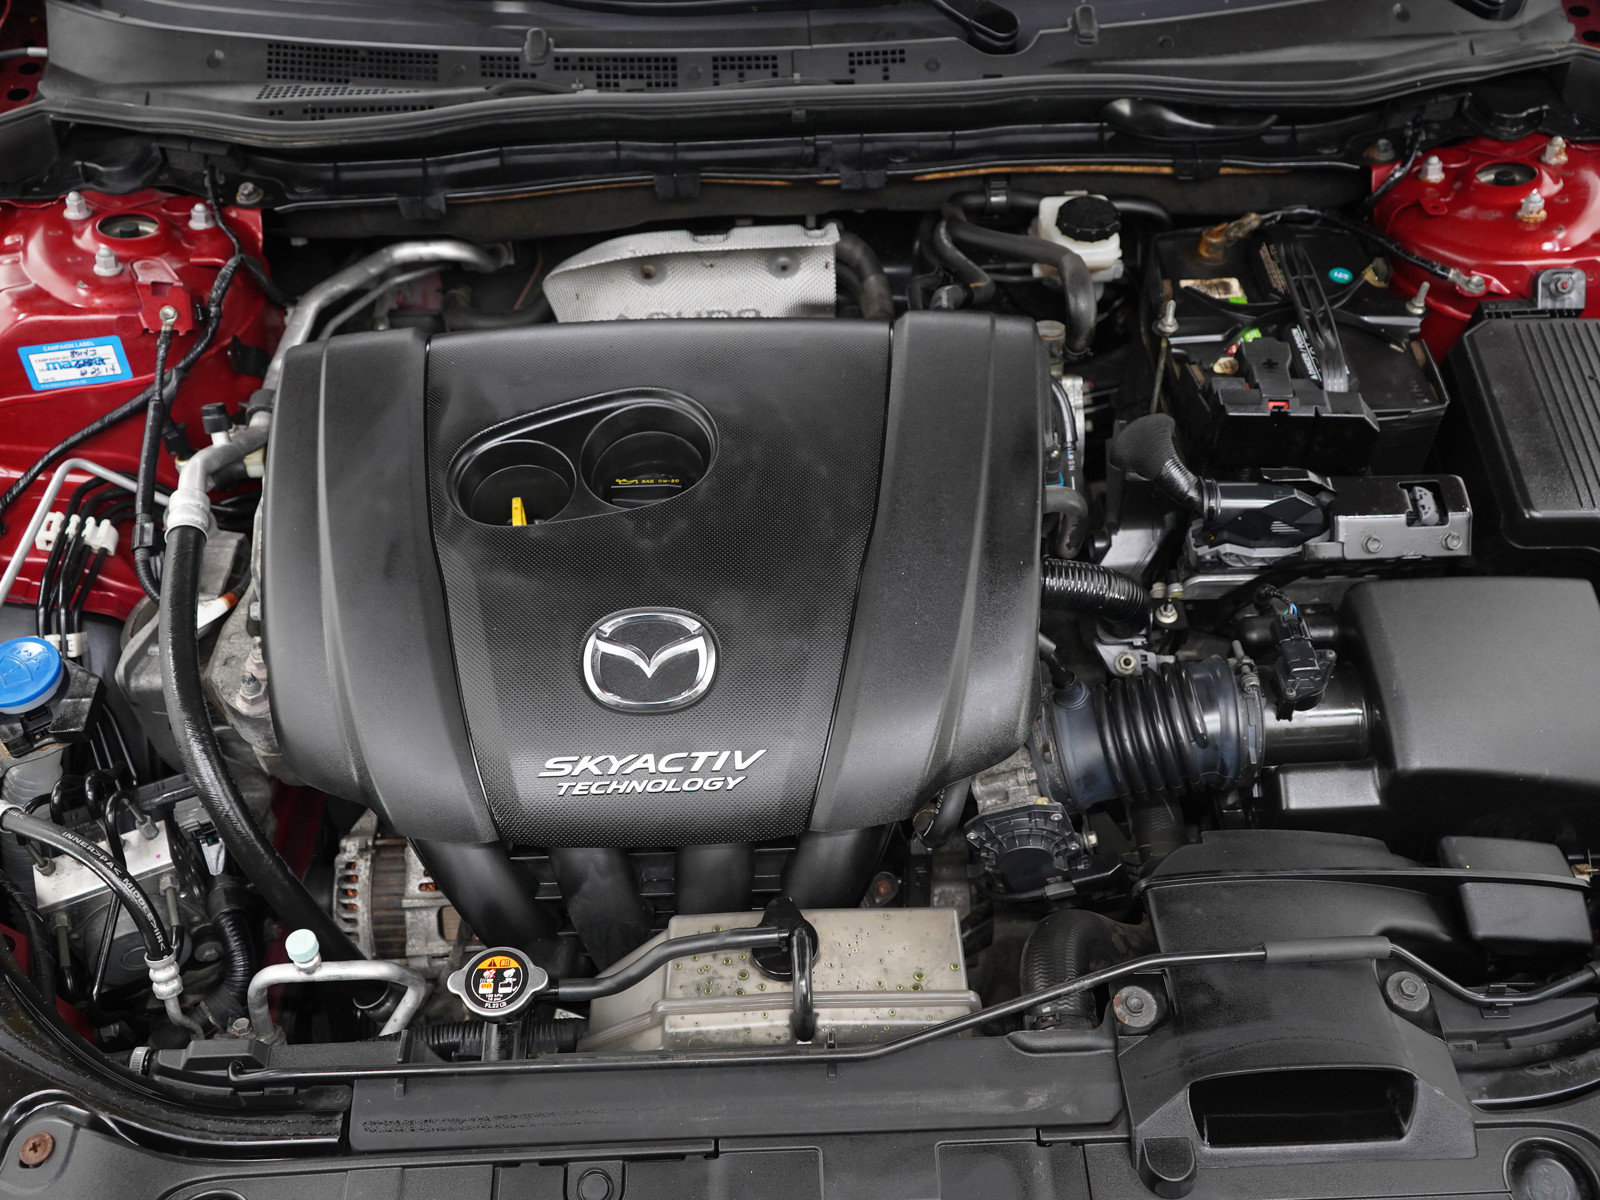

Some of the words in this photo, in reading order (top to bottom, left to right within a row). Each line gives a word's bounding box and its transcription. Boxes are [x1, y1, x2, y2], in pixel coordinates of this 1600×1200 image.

[43, 343, 74, 352] CAMPAIGN
[537, 749, 768, 777] SKYACTIV
[557, 776, 747, 796] TECHNOLOGY
